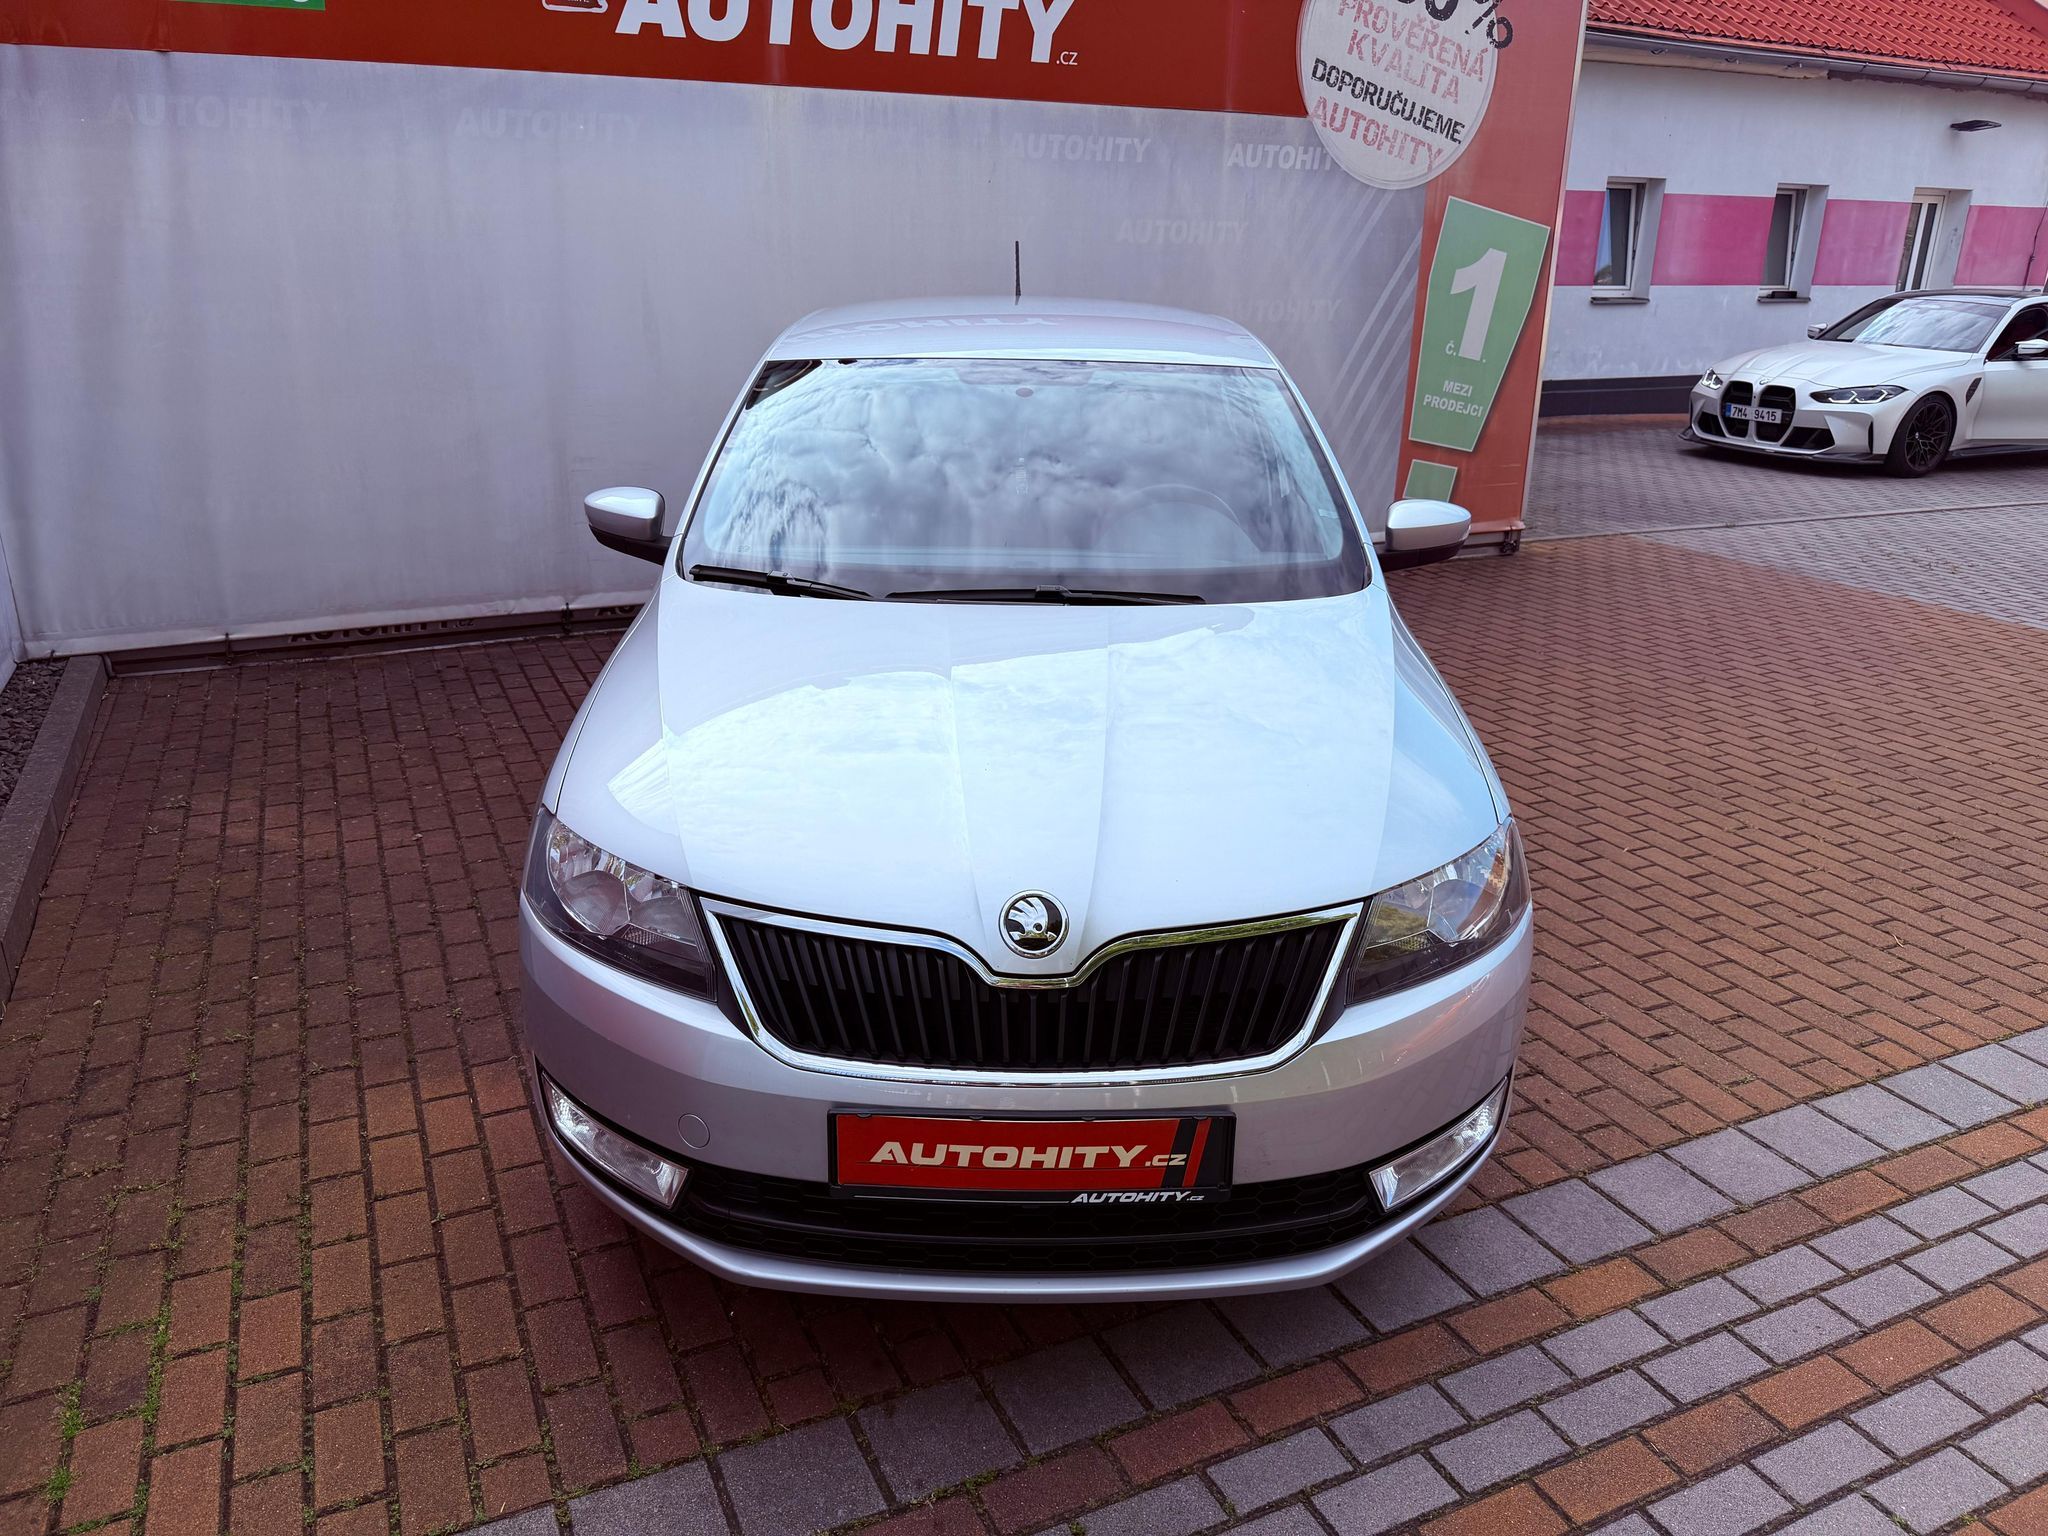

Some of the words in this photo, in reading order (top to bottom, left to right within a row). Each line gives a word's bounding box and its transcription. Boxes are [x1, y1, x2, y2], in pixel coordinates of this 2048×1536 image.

[1346, 28, 1460, 104] KVALITA
[105, 93, 328, 131] AUTOHITY
[1311, 57, 1466, 144] DOPORUČUJEME
[454, 106, 643, 142] AUTOHITY
[1309, 95, 1444, 173] AUTOHITY
[1006, 132, 1151, 163] AUTOHITY
[1226, 143, 1334, 170] AUTOHIT
[1116, 219, 1248, 245] AUTOHITY
[1443, 380, 1473, 397] MEZI
[1423, 394, 1484, 417] PRODEJCI
[1732, 406, 1748, 418] 7M4
[1754, 409, 1777, 422] 9415
